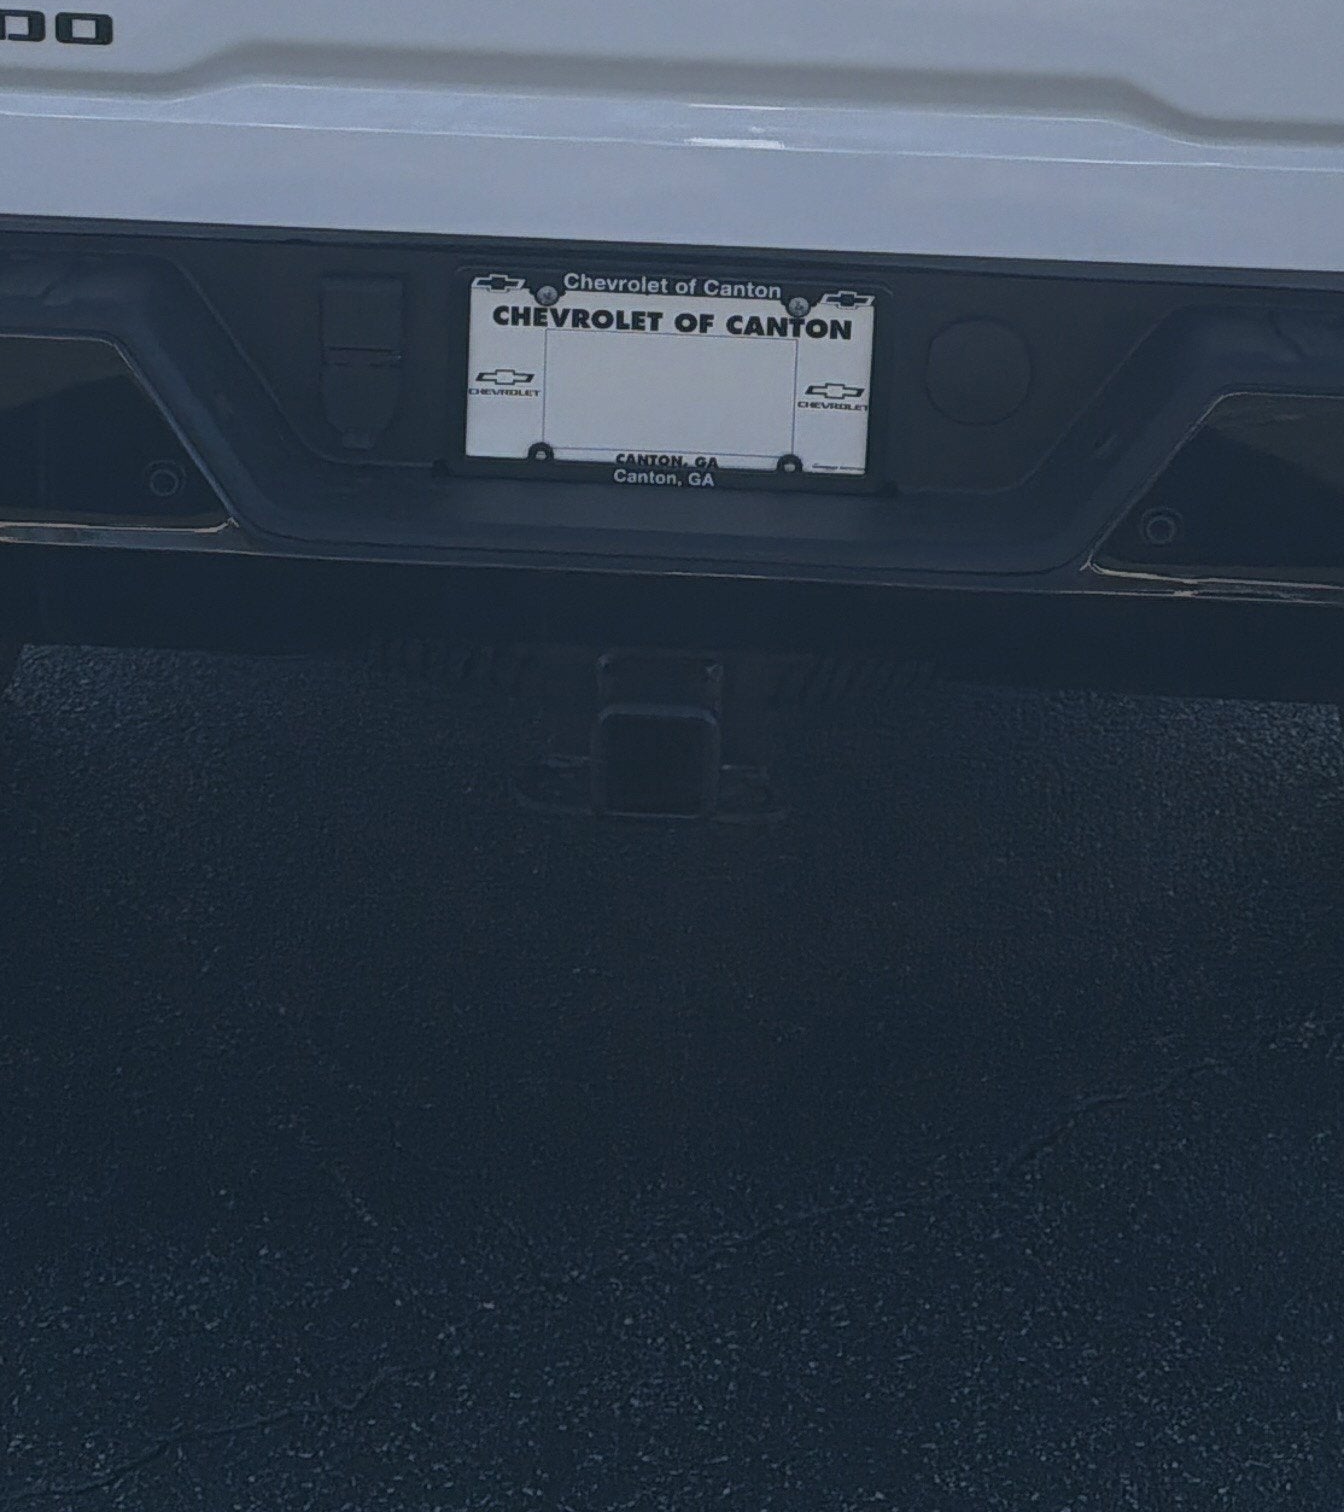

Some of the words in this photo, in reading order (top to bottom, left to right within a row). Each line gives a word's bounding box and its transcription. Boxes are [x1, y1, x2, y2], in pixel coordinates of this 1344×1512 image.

[563, 272, 668, 293] Chevrolet
[675, 279, 697, 295] of
[704, 279, 782, 299] Canton
[492, 305, 663, 331] CHEVROLET
[674, 313, 714, 334] OF
[726, 315, 852, 340] CANTON
[695, 456, 719, 469] GA
[613, 469, 683, 487] Canton,
[688, 472, 715, 487] GA
